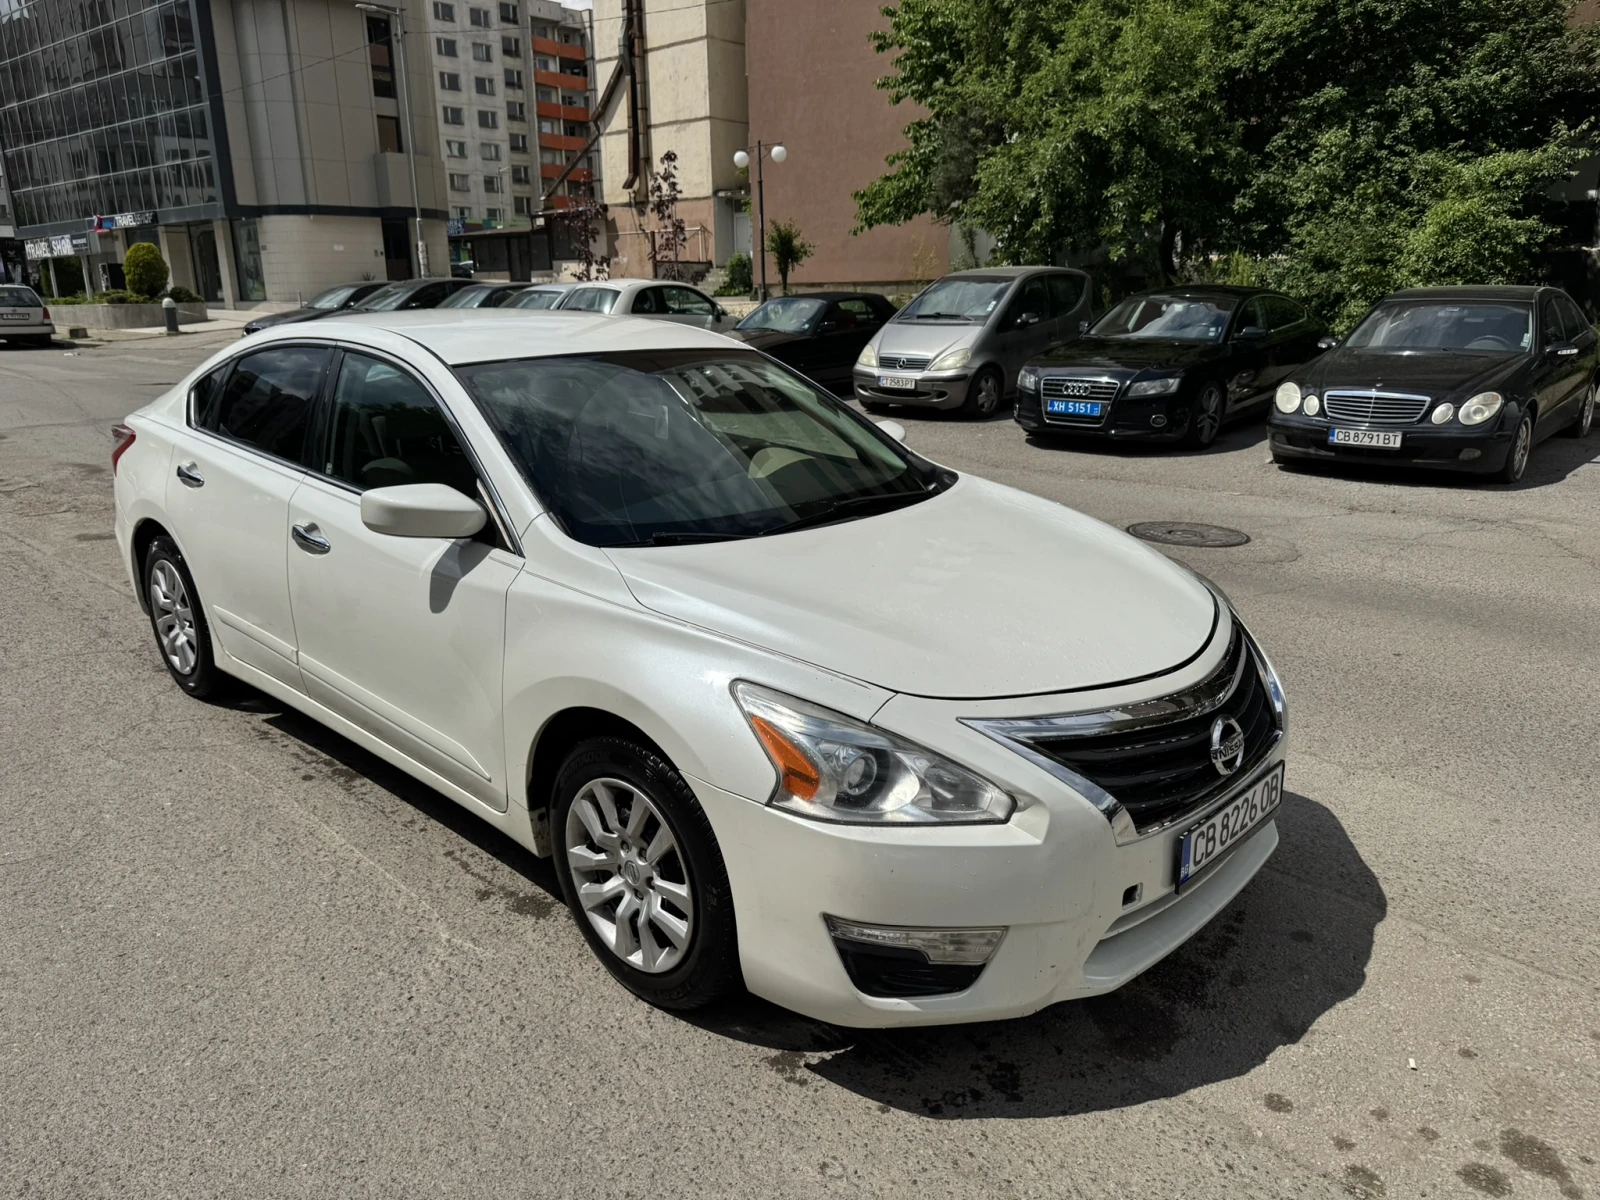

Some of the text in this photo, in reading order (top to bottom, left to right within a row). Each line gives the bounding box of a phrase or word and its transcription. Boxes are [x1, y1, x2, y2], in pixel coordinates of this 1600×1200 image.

[115, 214, 136, 227] TRAVEL
[27, 238, 73, 259] TRAVEL SHOP
[1053, 401, 1065, 412] XH
[1068, 402, 1091, 414] 5151
[1336, 430, 1350, 442] CB
[1353, 432, 1380, 444] 8791
[1383, 434, 1399, 445] BT
[1219, 738, 1245, 759] NISSA
[1193, 773, 1279, 867] CB 8226 OB
[1180, 864, 1189, 878] BG
